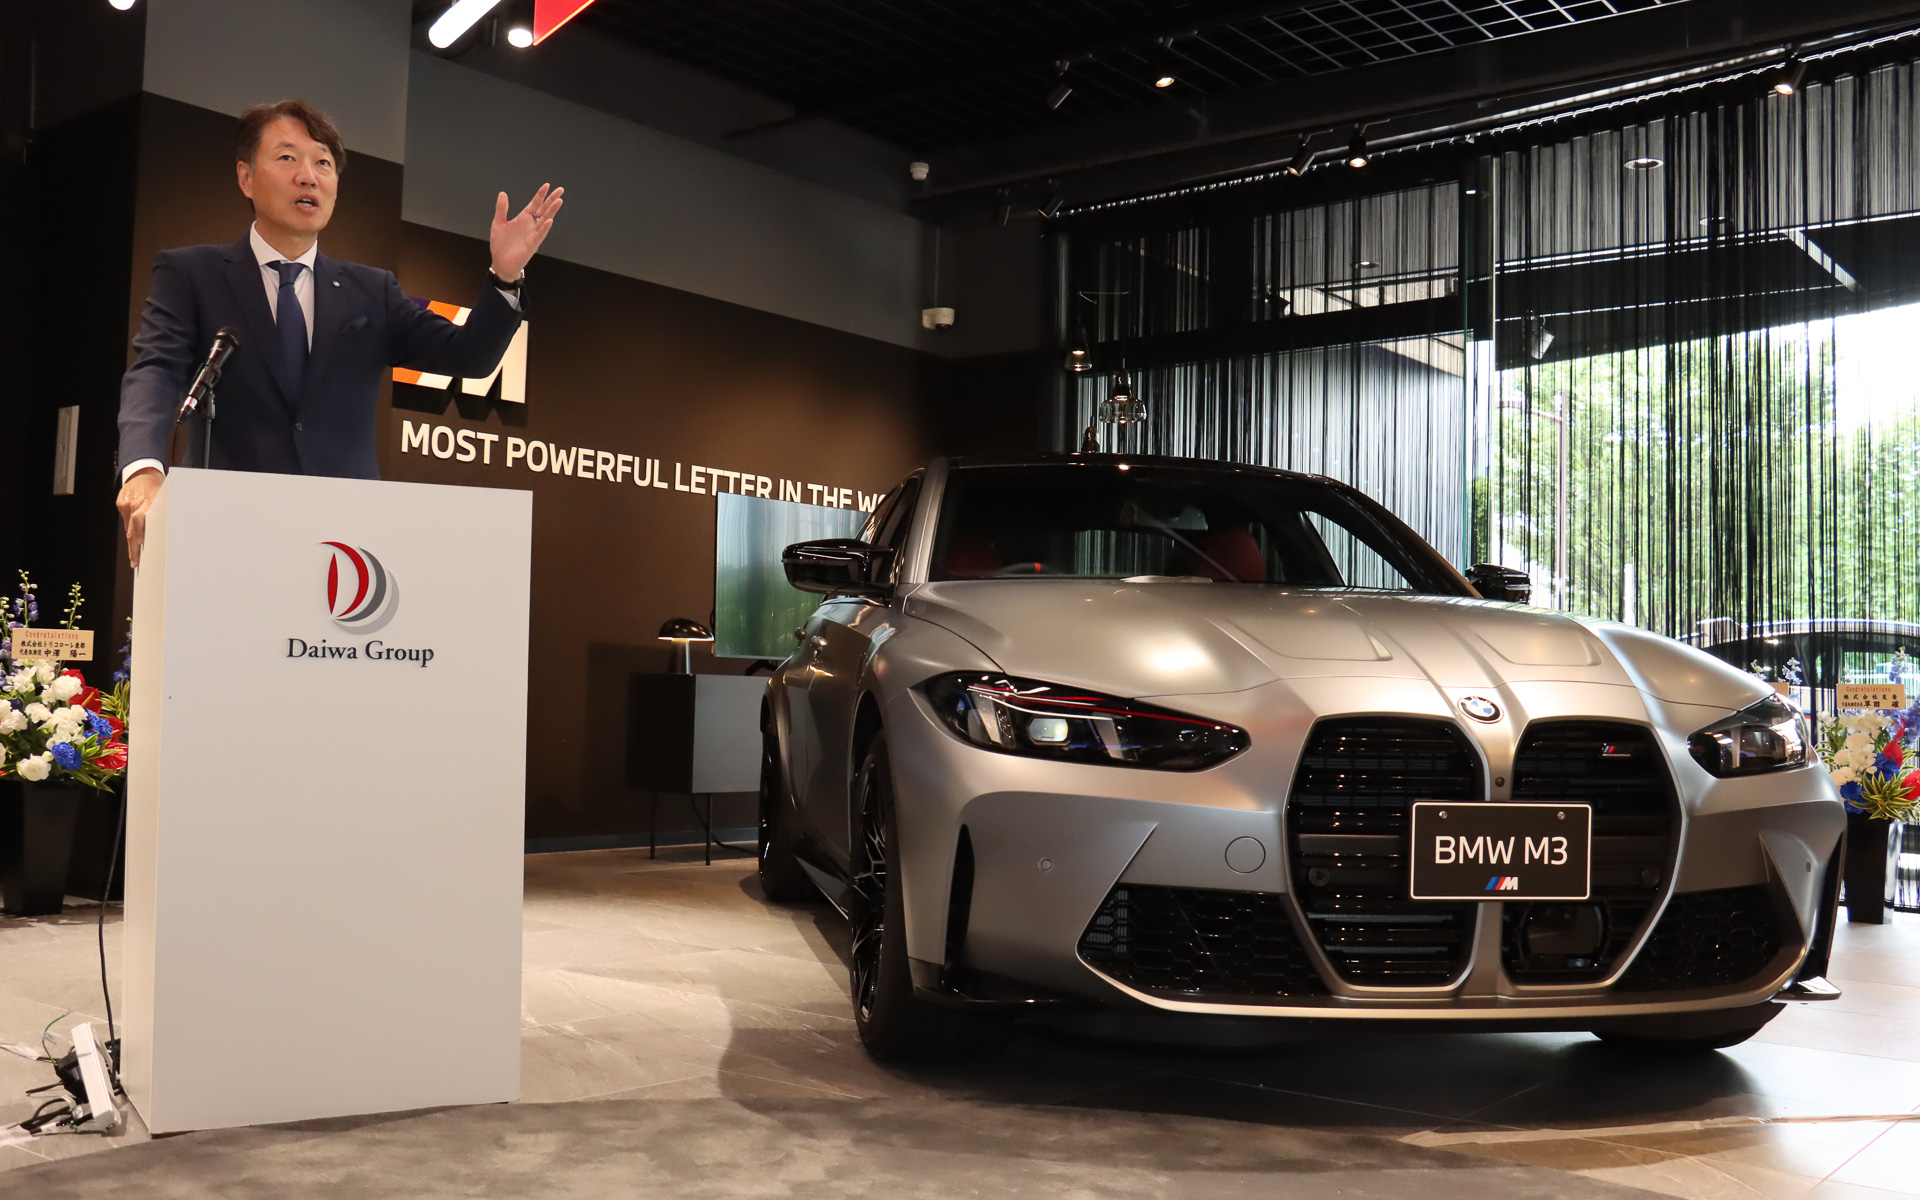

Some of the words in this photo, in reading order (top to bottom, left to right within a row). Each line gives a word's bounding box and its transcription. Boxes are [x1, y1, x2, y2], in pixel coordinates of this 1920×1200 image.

[401, 419, 499, 465] MOST
[506, 436, 668, 490] POWERFUL
[674, 462, 773, 499] LETTER
[779, 478, 802, 503] IN
[25, 630, 79, 640] Congratulations
[286, 637, 358, 659] Daiwa
[365, 639, 435, 668] Group
[1435, 835, 1515, 864] BMW
[1524, 836, 1568, 865] M3
